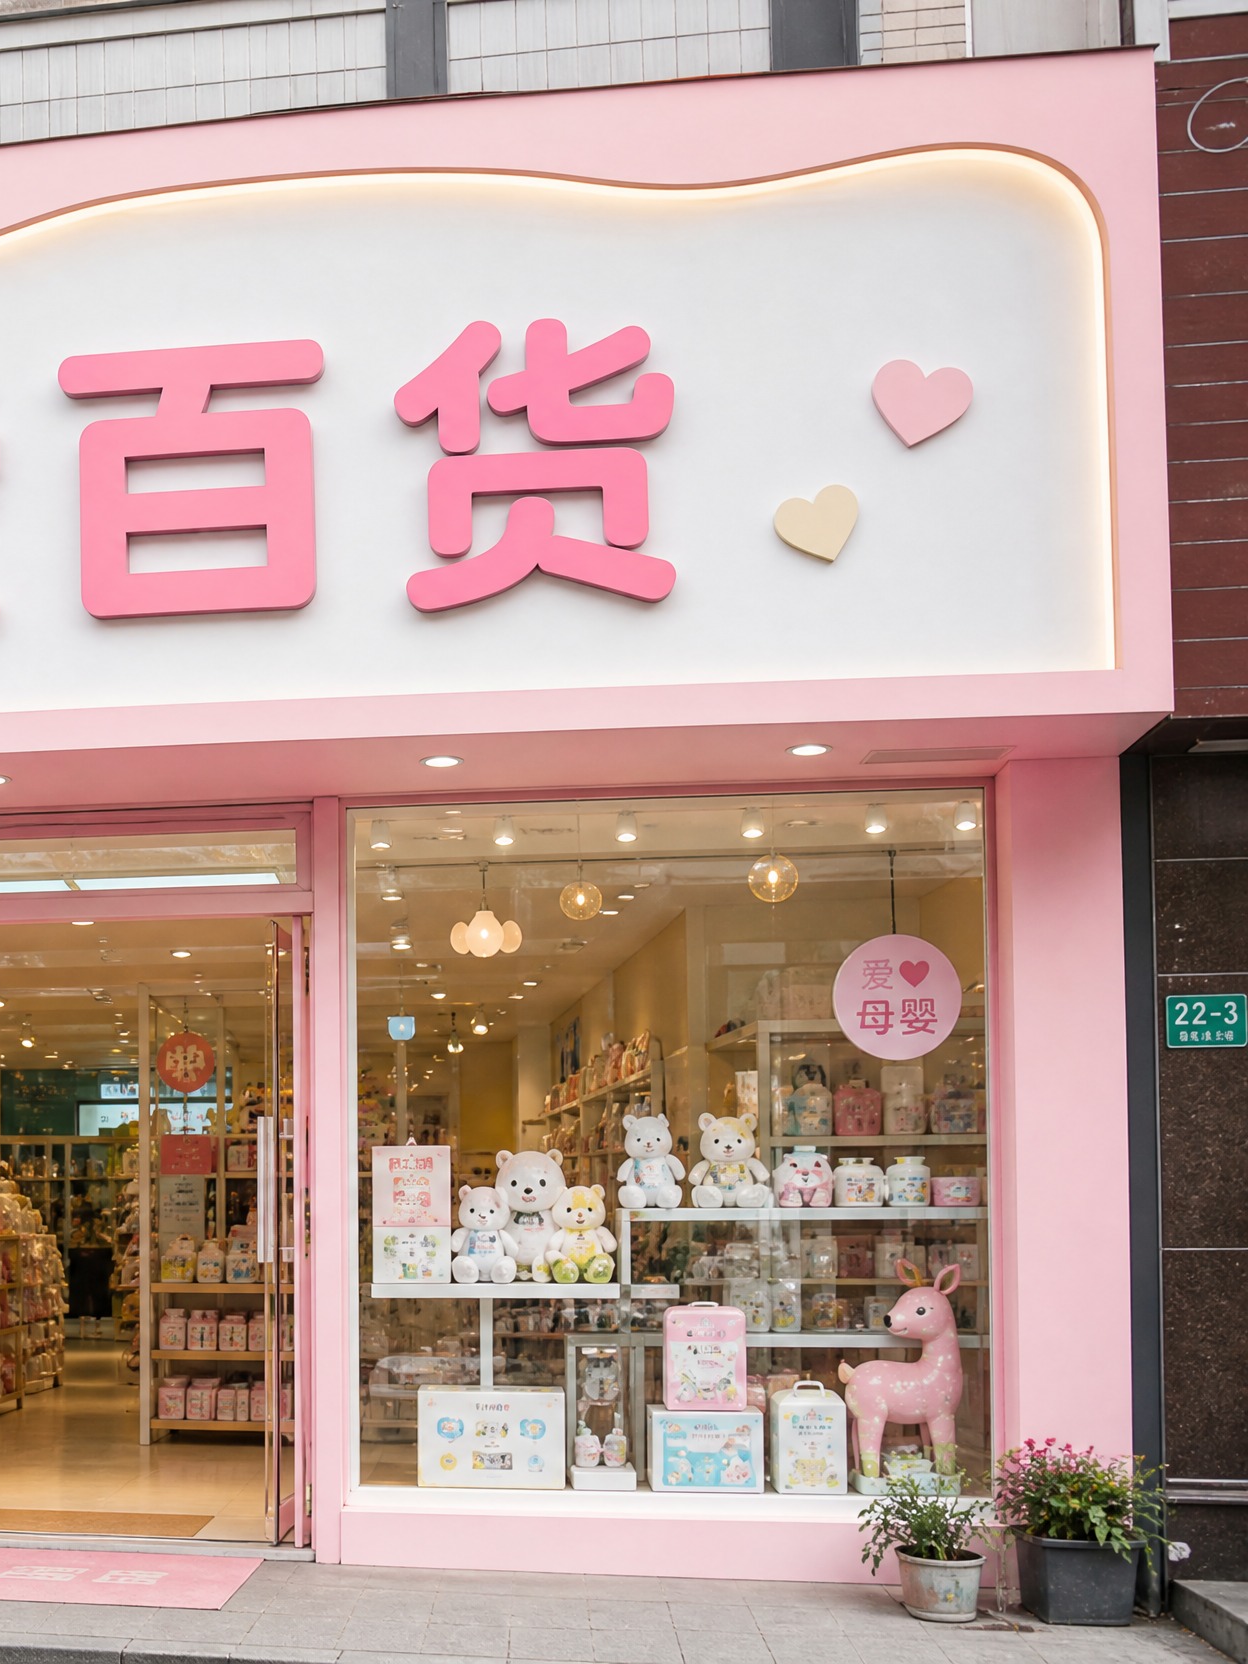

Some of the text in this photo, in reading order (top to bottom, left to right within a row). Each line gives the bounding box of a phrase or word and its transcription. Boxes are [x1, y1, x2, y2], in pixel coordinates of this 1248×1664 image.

[861, 959, 894, 991] 爱
[856, 998, 939, 1036] 母婴
[1174, 1001, 1239, 1026] 22-3
